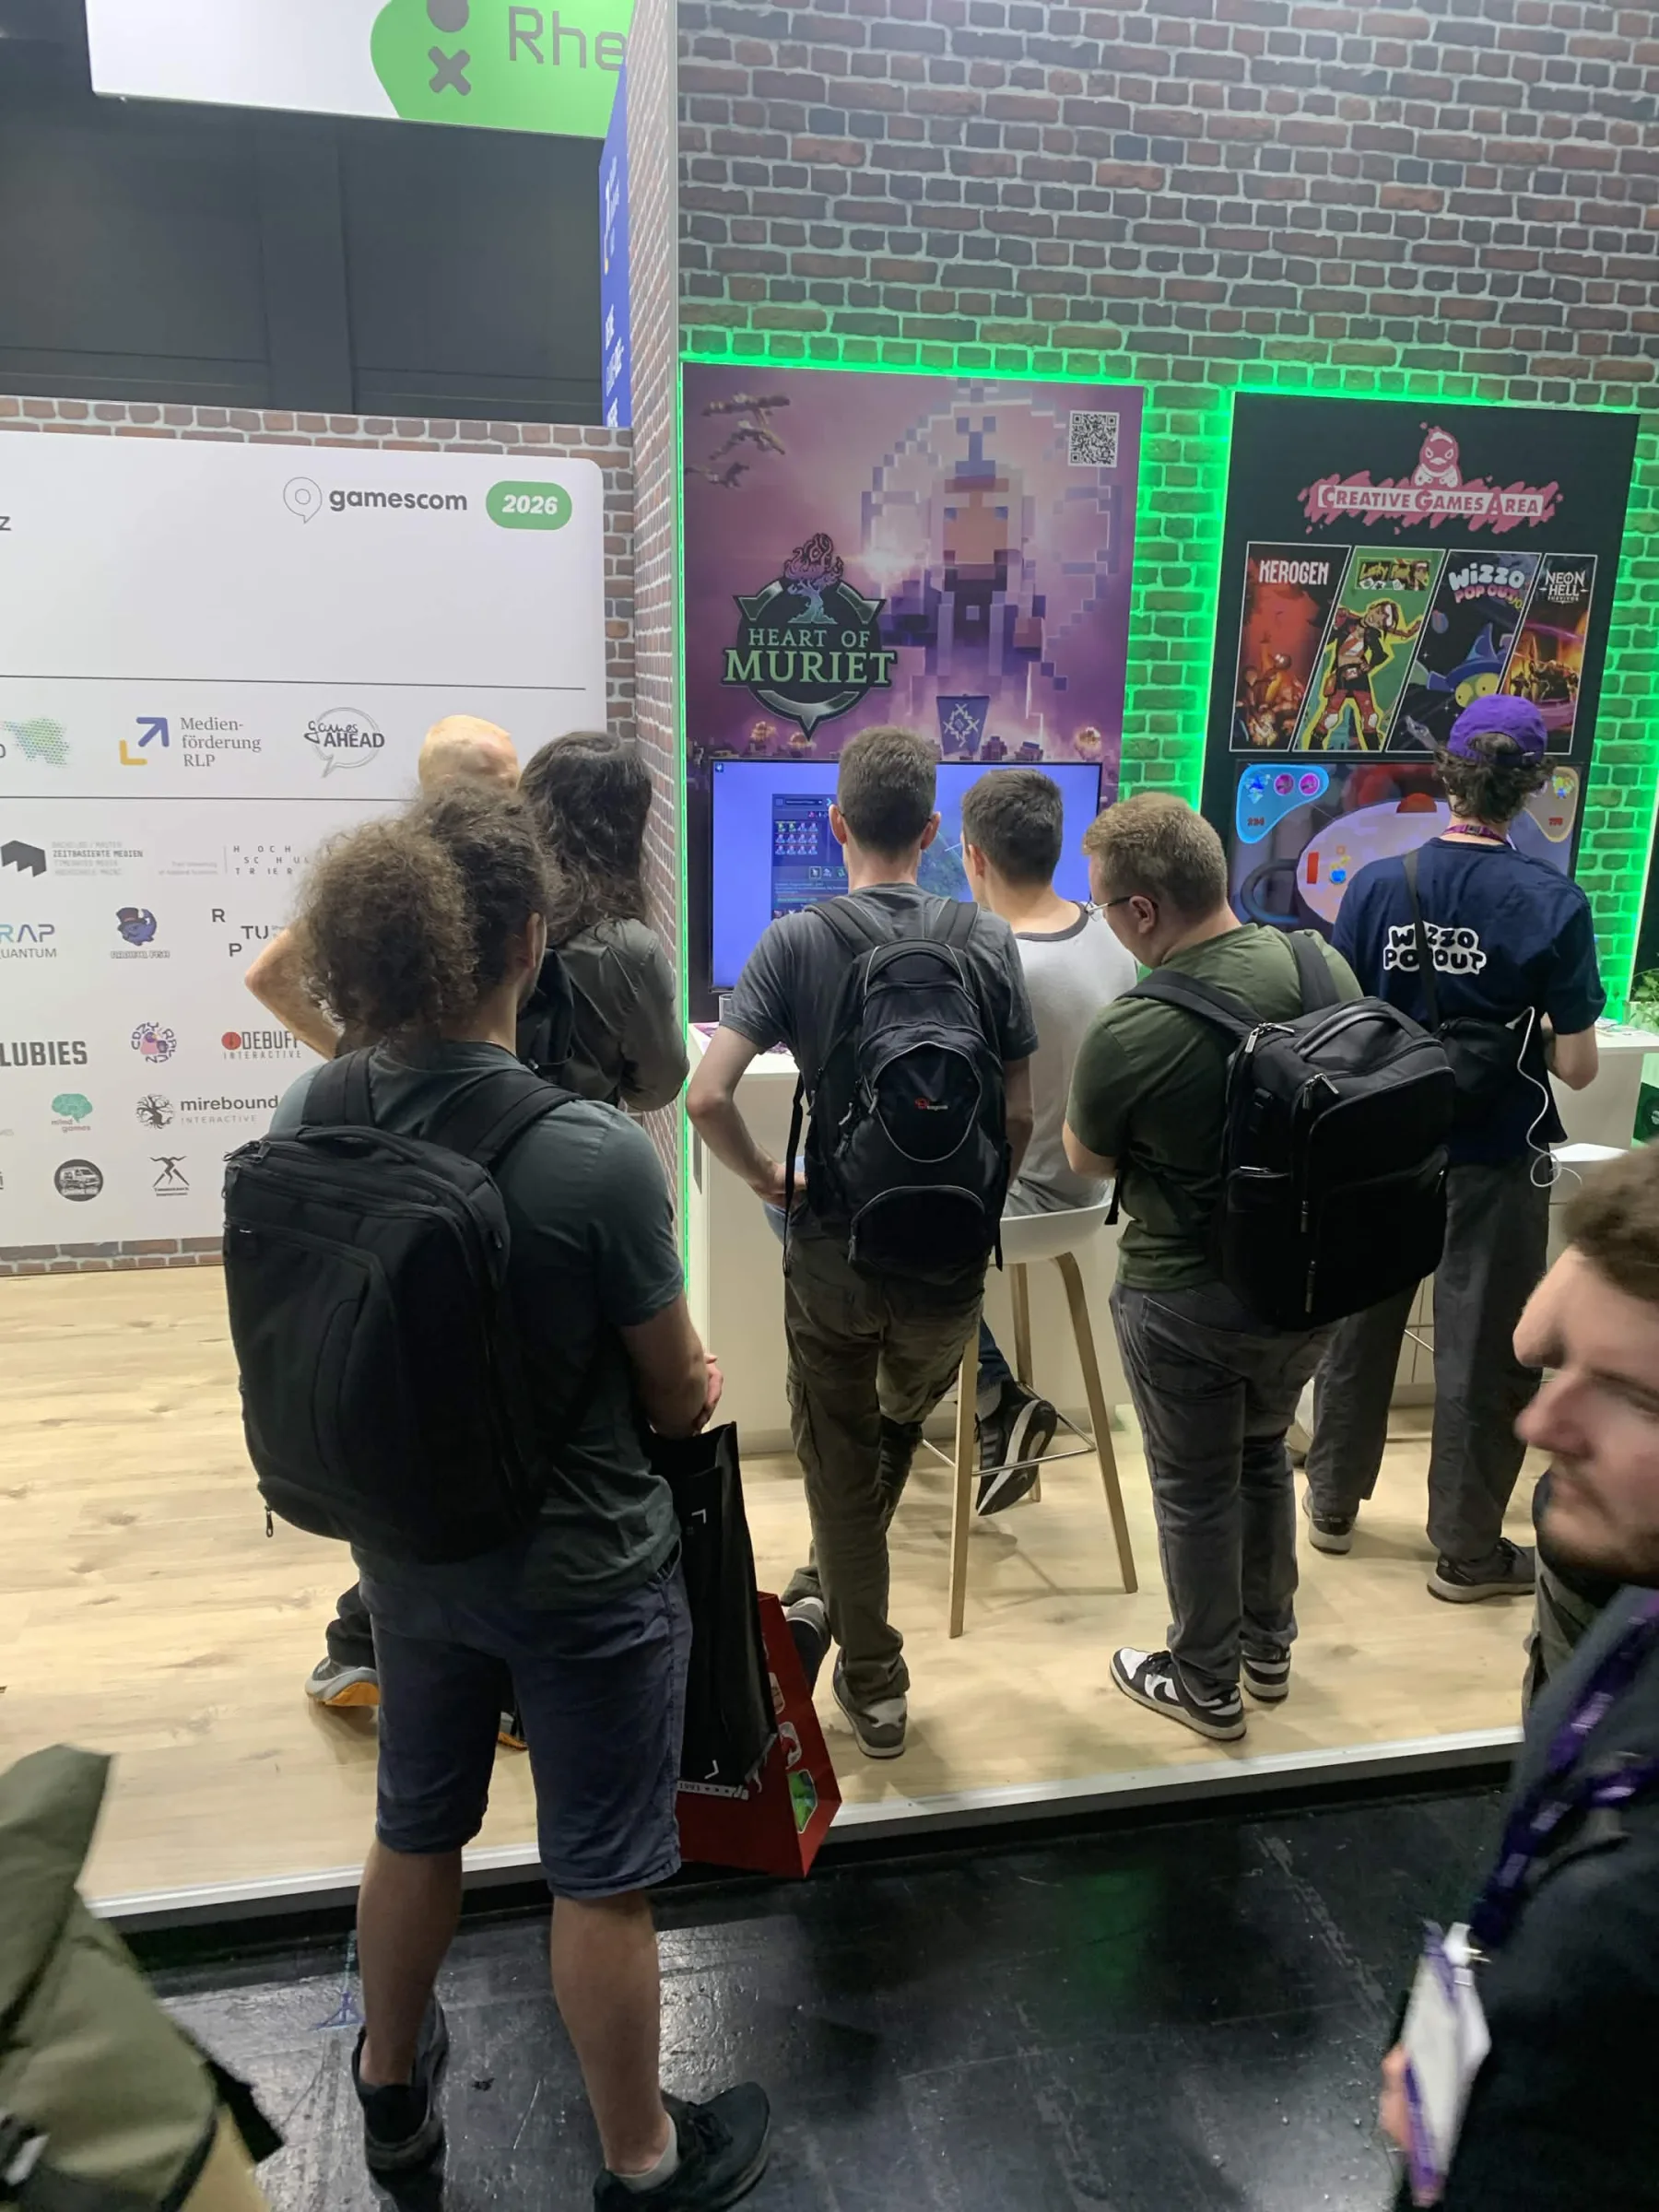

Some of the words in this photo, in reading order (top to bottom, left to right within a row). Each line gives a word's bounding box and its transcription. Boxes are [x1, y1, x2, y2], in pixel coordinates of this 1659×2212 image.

[329, 489, 468, 512] gamescom
[501, 494, 559, 515] 2026
[1322, 486, 1411, 509] CREATIVE
[1415, 488, 1484, 512] GAMES
[1487, 492, 1539, 515] AREA
[1258, 559, 1329, 585] KEROGEN
[1545, 569, 1586, 587] NEON
[1548, 584, 1580, 597] HELL
[747, 628, 828, 647] HEART
[841, 629, 871, 648] OF
[723, 650, 896, 684] MURIET
[180, 716, 244, 731] Medien-
[182, 734, 262, 754] förderung
[324, 732, 385, 748] AHEAD
[183, 753, 216, 767] RLP
[112, 850, 144, 858] MEDIEN
[0, 947, 57, 959] UANTUM
[1434, 948, 1484, 971] OUT
[223, 1050, 302, 1060] INTERACTIVE
[180, 1095, 278, 1112] mirebound
[181, 1114, 257, 1124] INTERACTIVE
